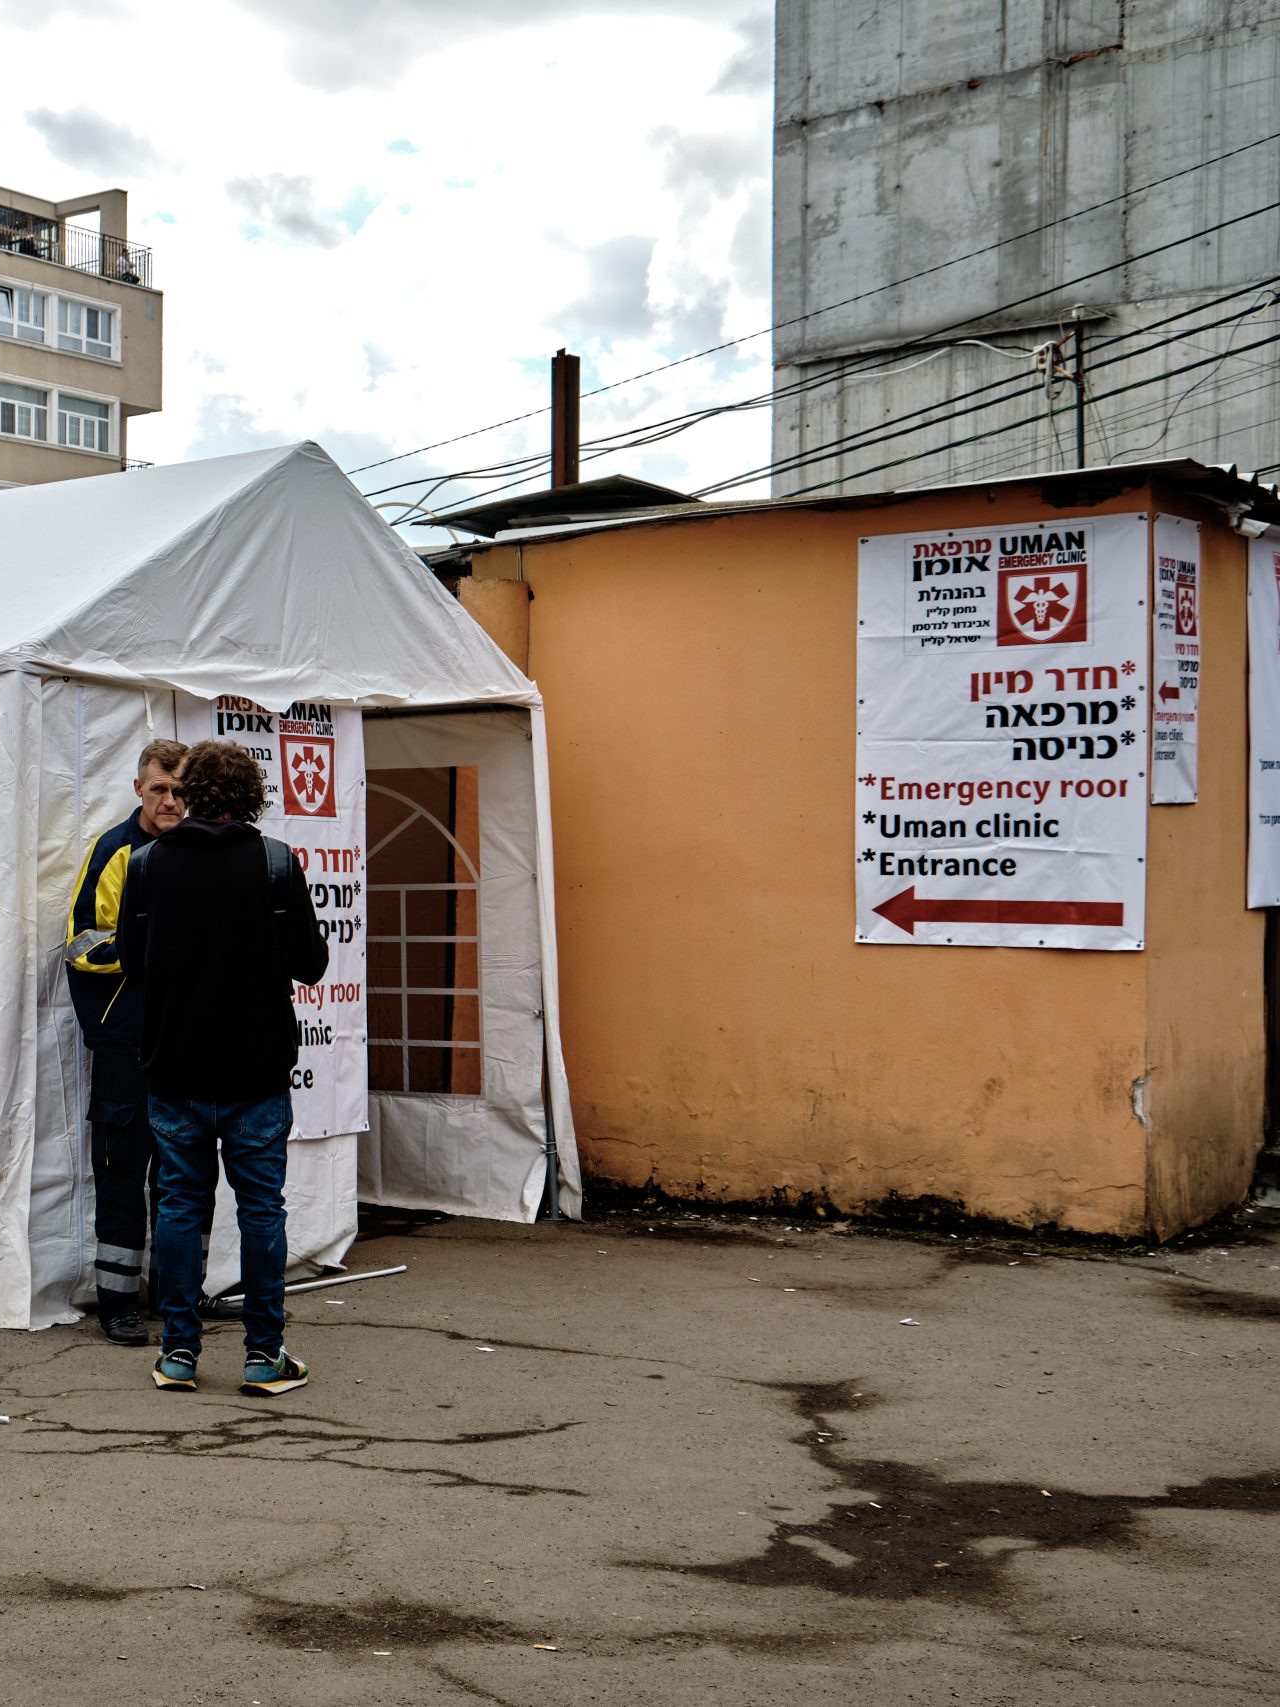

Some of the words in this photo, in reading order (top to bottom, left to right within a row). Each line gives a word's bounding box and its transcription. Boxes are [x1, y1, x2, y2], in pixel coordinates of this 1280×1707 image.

[913, 538, 992, 559] מרפאת
[1000, 531, 1085, 556] UMAN
[912, 555, 991, 582] אומן
[998, 553, 1054, 569] EMERGENCY
[1056, 550, 1087, 565] CLINIC
[918, 586, 986, 602] בהנהלת
[926, 606, 950, 617] קליין
[953, 605, 977, 616] נחמן
[912, 620, 948, 633] לנדסמן
[951, 619, 991, 629] אביגדור
[921, 635, 945, 647] קליין
[947, 634, 981, 644] ישראל
[971, 669, 1034, 702] מיון
[217, 712, 274, 735] אומן
[279, 720, 315, 735] EMERGENCY
[315, 724, 334, 737] CLINIC
[975, 812, 1059, 838] clinic
[298, 1019, 331, 1046] linic
